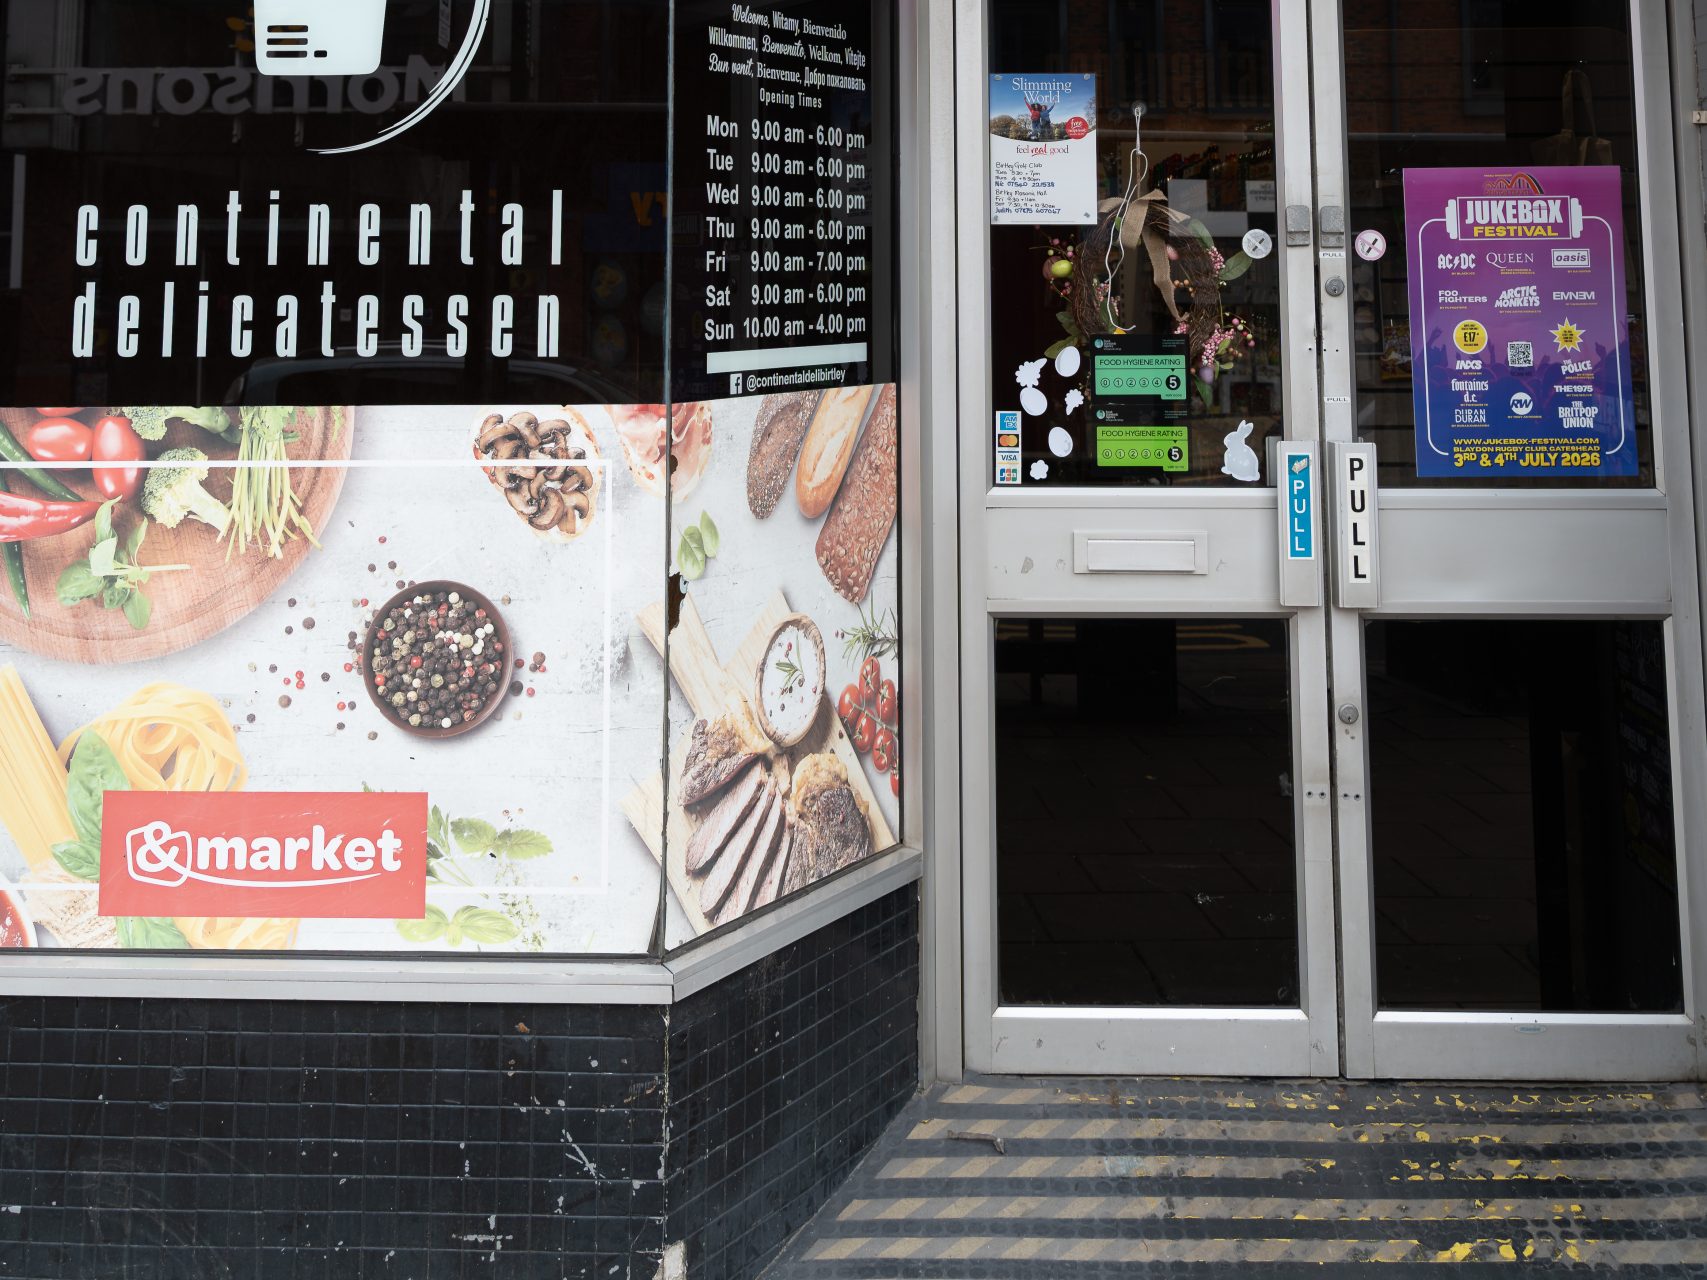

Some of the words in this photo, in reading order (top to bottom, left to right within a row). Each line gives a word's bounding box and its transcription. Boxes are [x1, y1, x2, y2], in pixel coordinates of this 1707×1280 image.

[732, 4, 770, 28] Welcome,
[772, 10, 800, 36] Witamy,
[803, 18, 847, 40] Bienvenido
[708, 26, 758, 52] Willkommen,
[762, 34, 806, 60] Benvenuto,
[809, 44, 842, 65] Welkom,
[708, 53, 730, 73] Bun
[732, 58, 754, 78] venit,
[756, 62, 802, 84] Bienvenue,
[804, 66, 826, 90] Добро
[826, 76, 866, 92] пожаловать
[1012, 77, 1072, 94] Slimming
[760, 88, 794, 109] Opening
[798, 92, 822, 108] Times
[1024, 91, 1060, 103] World
[706, 114, 738, 138] Mon
[752, 118, 780, 142] 9.00
[784, 127, 804, 144] am
[816, 125, 842, 146] 6.00
[846, 132, 865, 152] pm
[1016, 144, 1029, 154] feel
[1031, 144, 1047, 156] real
[1050, 145, 1069, 156] good
[706, 148, 734, 171] Tue
[752, 152, 780, 174] 9.00
[784, 160, 804, 176] am
[816, 156, 842, 178] 6.00
[846, 163, 865, 183] pm
[706, 182, 739, 205] Wed
[752, 185, 780, 206] 9.00
[784, 191, 804, 207] am
[816, 188, 842, 208] 6.00
[846, 194, 865, 214] pm
[1466, 200, 1563, 224] JUKEBOX
[76, 190, 562, 265] continental
[706, 216, 735, 238] Thu
[751, 218, 780, 239] 9.00
[784, 223, 804, 239] am
[816, 220, 842, 240] 6.00
[846, 224, 865, 245] pm
[1474, 226, 1558, 237] FESTIVAL
[706, 250, 726, 272] Fri
[751, 251, 780, 272] 9.00
[784, 256, 804, 272] am
[816, 252, 842, 272] 7.00
[846, 256, 865, 276] pm
[1486, 252, 1534, 268] QUEEN
[1556, 252, 1587, 262] oasis
[705, 284, 730, 307] Sat
[752, 284, 780, 306] 9.00
[784, 287, 804, 304] am
[816, 283, 842, 303] 6.00
[846, 286, 865, 307] pm
[1494, 296, 1540, 308] MONKEYS
[1499, 285, 1537, 299] ARCTIC
[72, 281, 560, 357] delicatessen
[704, 318, 734, 341] Sun
[743, 316, 780, 338] 10.00
[784, 319, 804, 336] am
[816, 314, 842, 334] 4.00
[846, 317, 865, 338] pm
[1561, 360, 1593, 375] POLICE
[746, 368, 846, 392] @continentaldelibirtley
[1451, 378, 1488, 392] fontaines
[1511, 399, 1532, 408] RW
[1558, 406, 1598, 418] BRITPOP
[1455, 415, 1486, 423] DURAN
[1563, 417, 1594, 428] UNION
[1454, 453, 1477, 467] 3RD
[1480, 454, 1492, 467] &
[1494, 453, 1517, 467] 4TH
[1520, 453, 1558, 467] JULY
[1561, 453, 1601, 467] 2026
[1294, 480, 1306, 551] PULL
[1350, 458, 1366, 578] PULL
